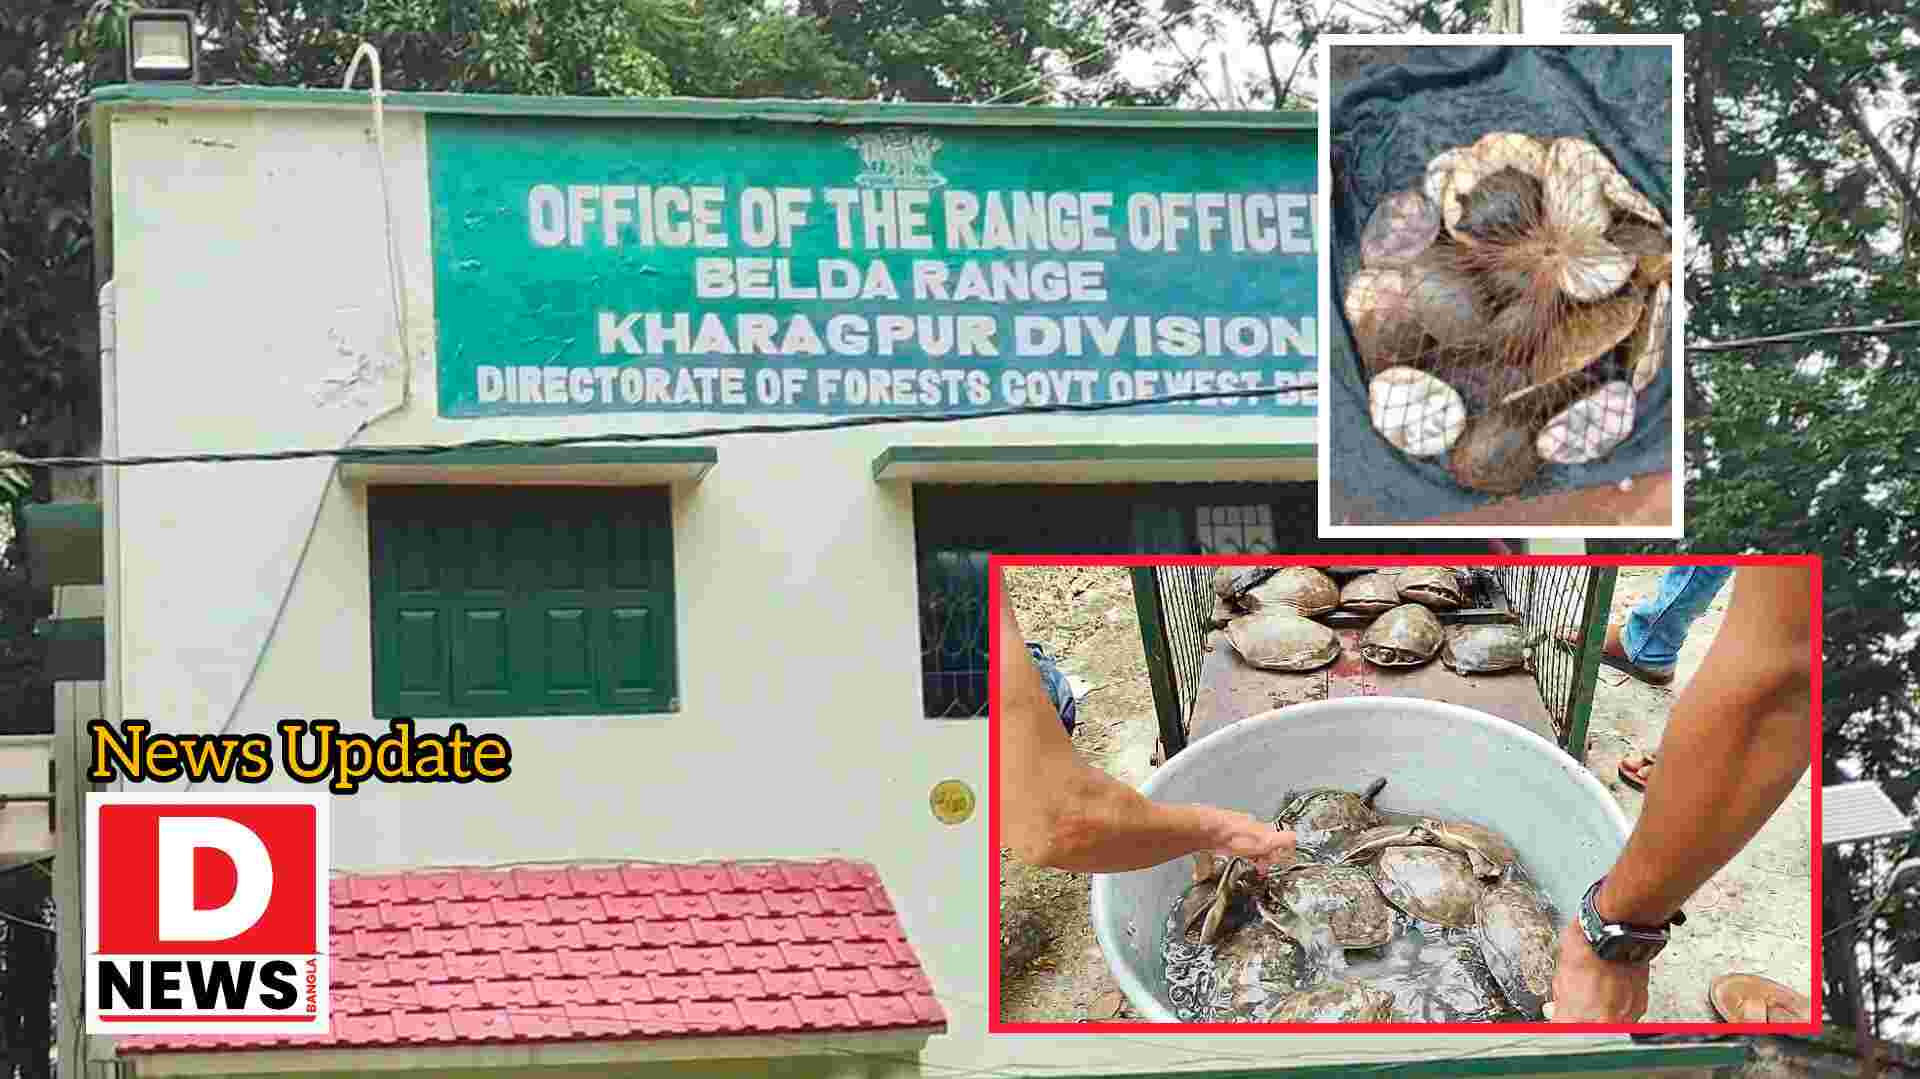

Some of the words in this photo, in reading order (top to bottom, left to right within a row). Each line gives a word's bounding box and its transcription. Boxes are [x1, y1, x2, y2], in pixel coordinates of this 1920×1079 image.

[528, 184, 728, 249] OFFICE
[739, 186, 810, 249] OF
[825, 187, 933, 251] THE
[944, 191, 1117, 252] RANGE
[1127, 193, 1317, 255] OFFICE
[695, 257, 898, 301] BELDA
[911, 260, 1108, 302] RANGE
[598, 312, 999, 358] KHARAGPUR
[1014, 316, 1317, 359] DIVISION
[476, 366, 746, 405] DIRECTORATE
[757, 369, 808, 406] OF
[818, 369, 991, 408] FORESTS
